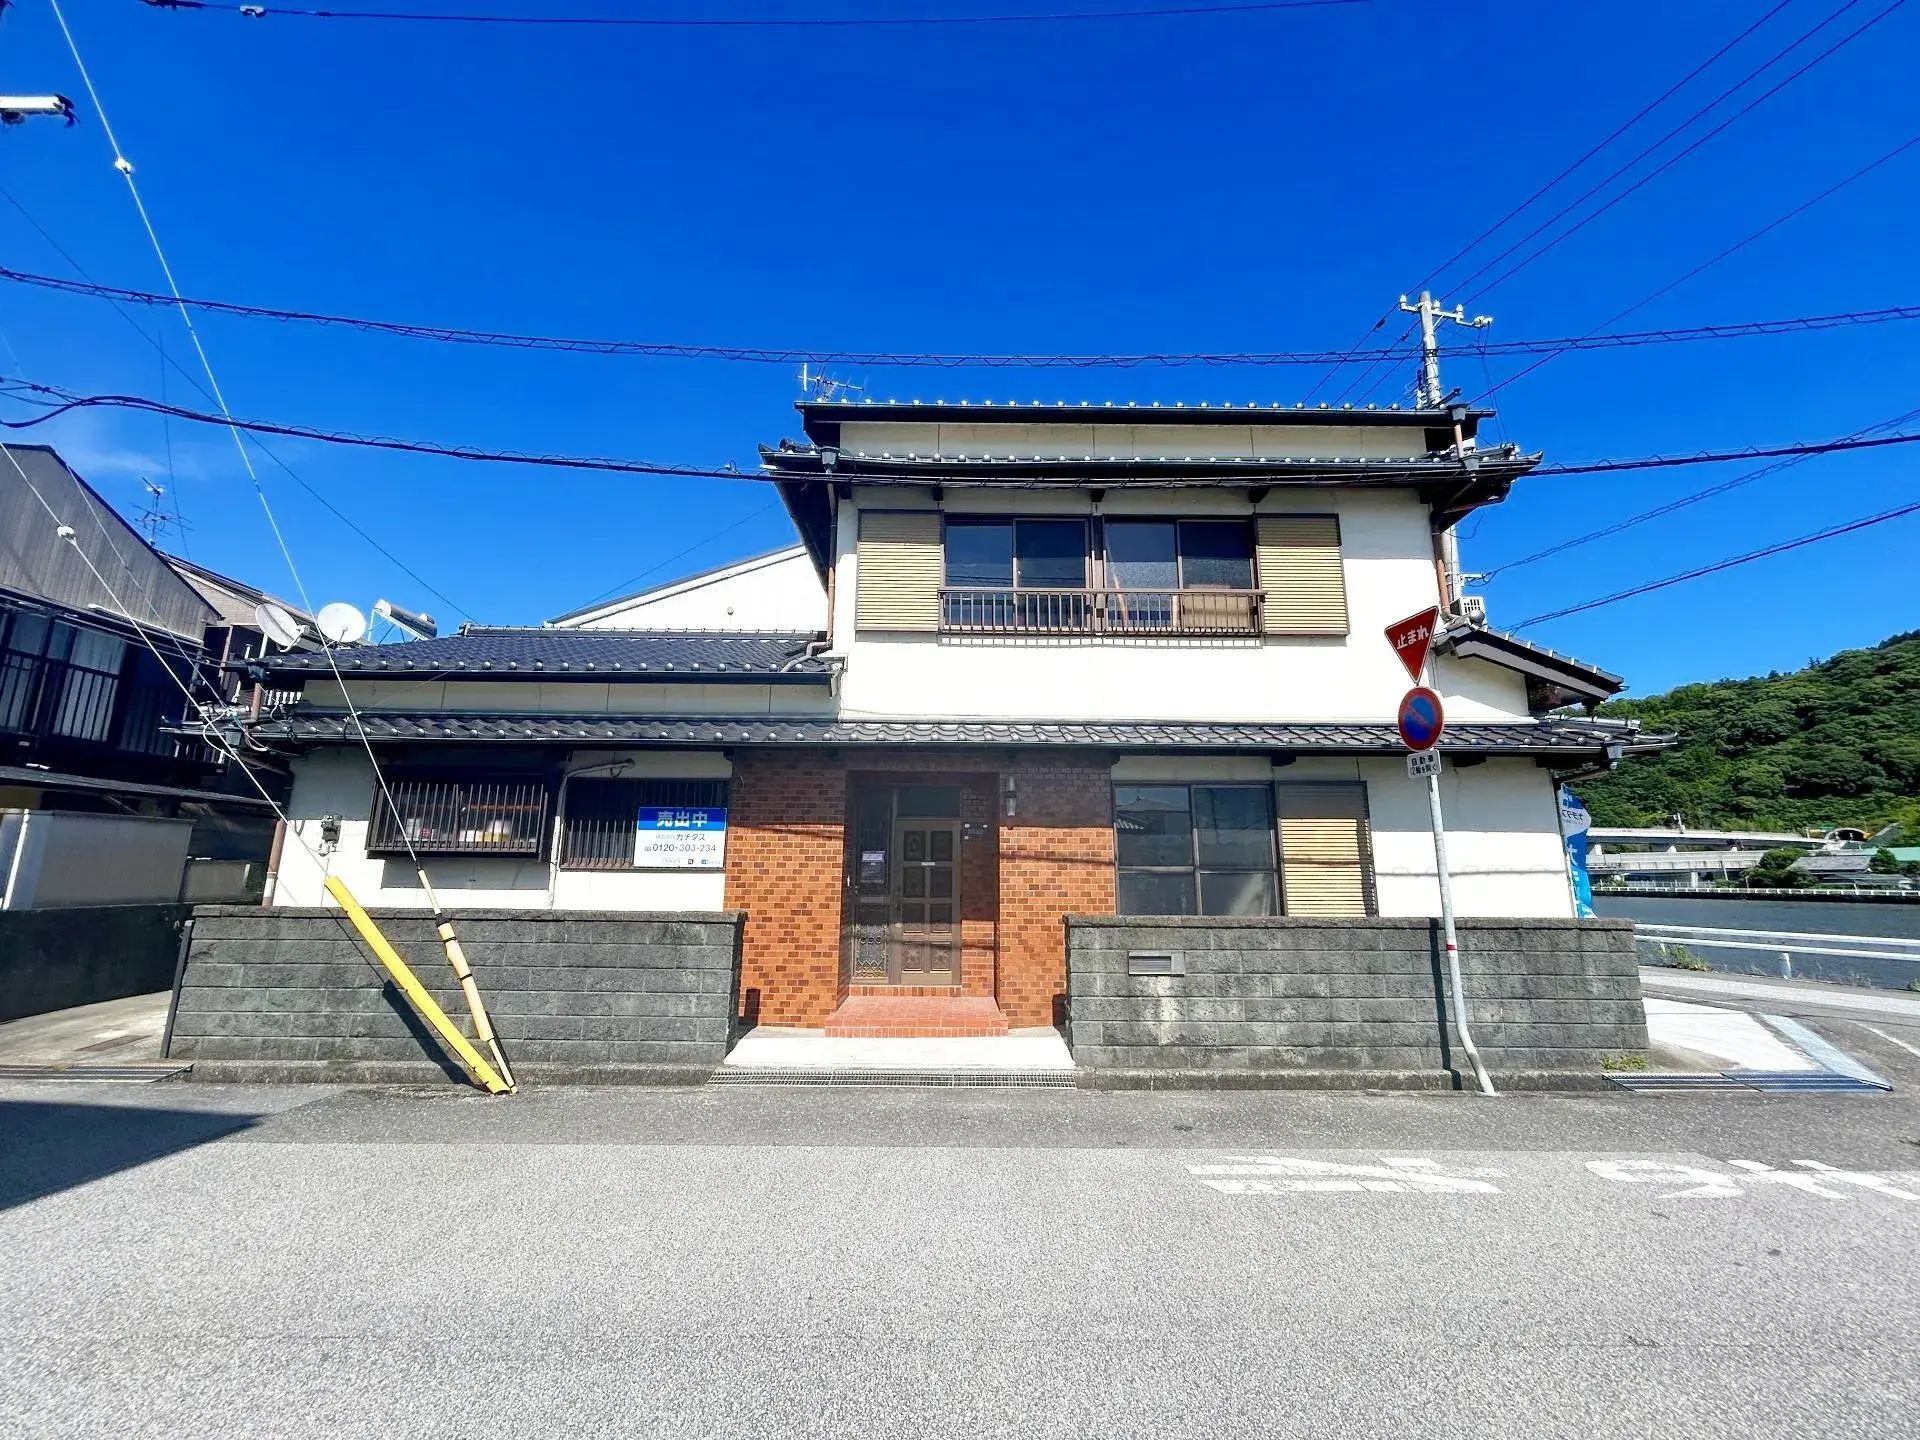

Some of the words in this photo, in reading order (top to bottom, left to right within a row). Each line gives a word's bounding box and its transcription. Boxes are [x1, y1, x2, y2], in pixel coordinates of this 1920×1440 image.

[1397, 625, 1429, 649] 止まれ
[656, 811, 708, 828] 売出中
[652, 844, 716, 852] 0120-303-234
